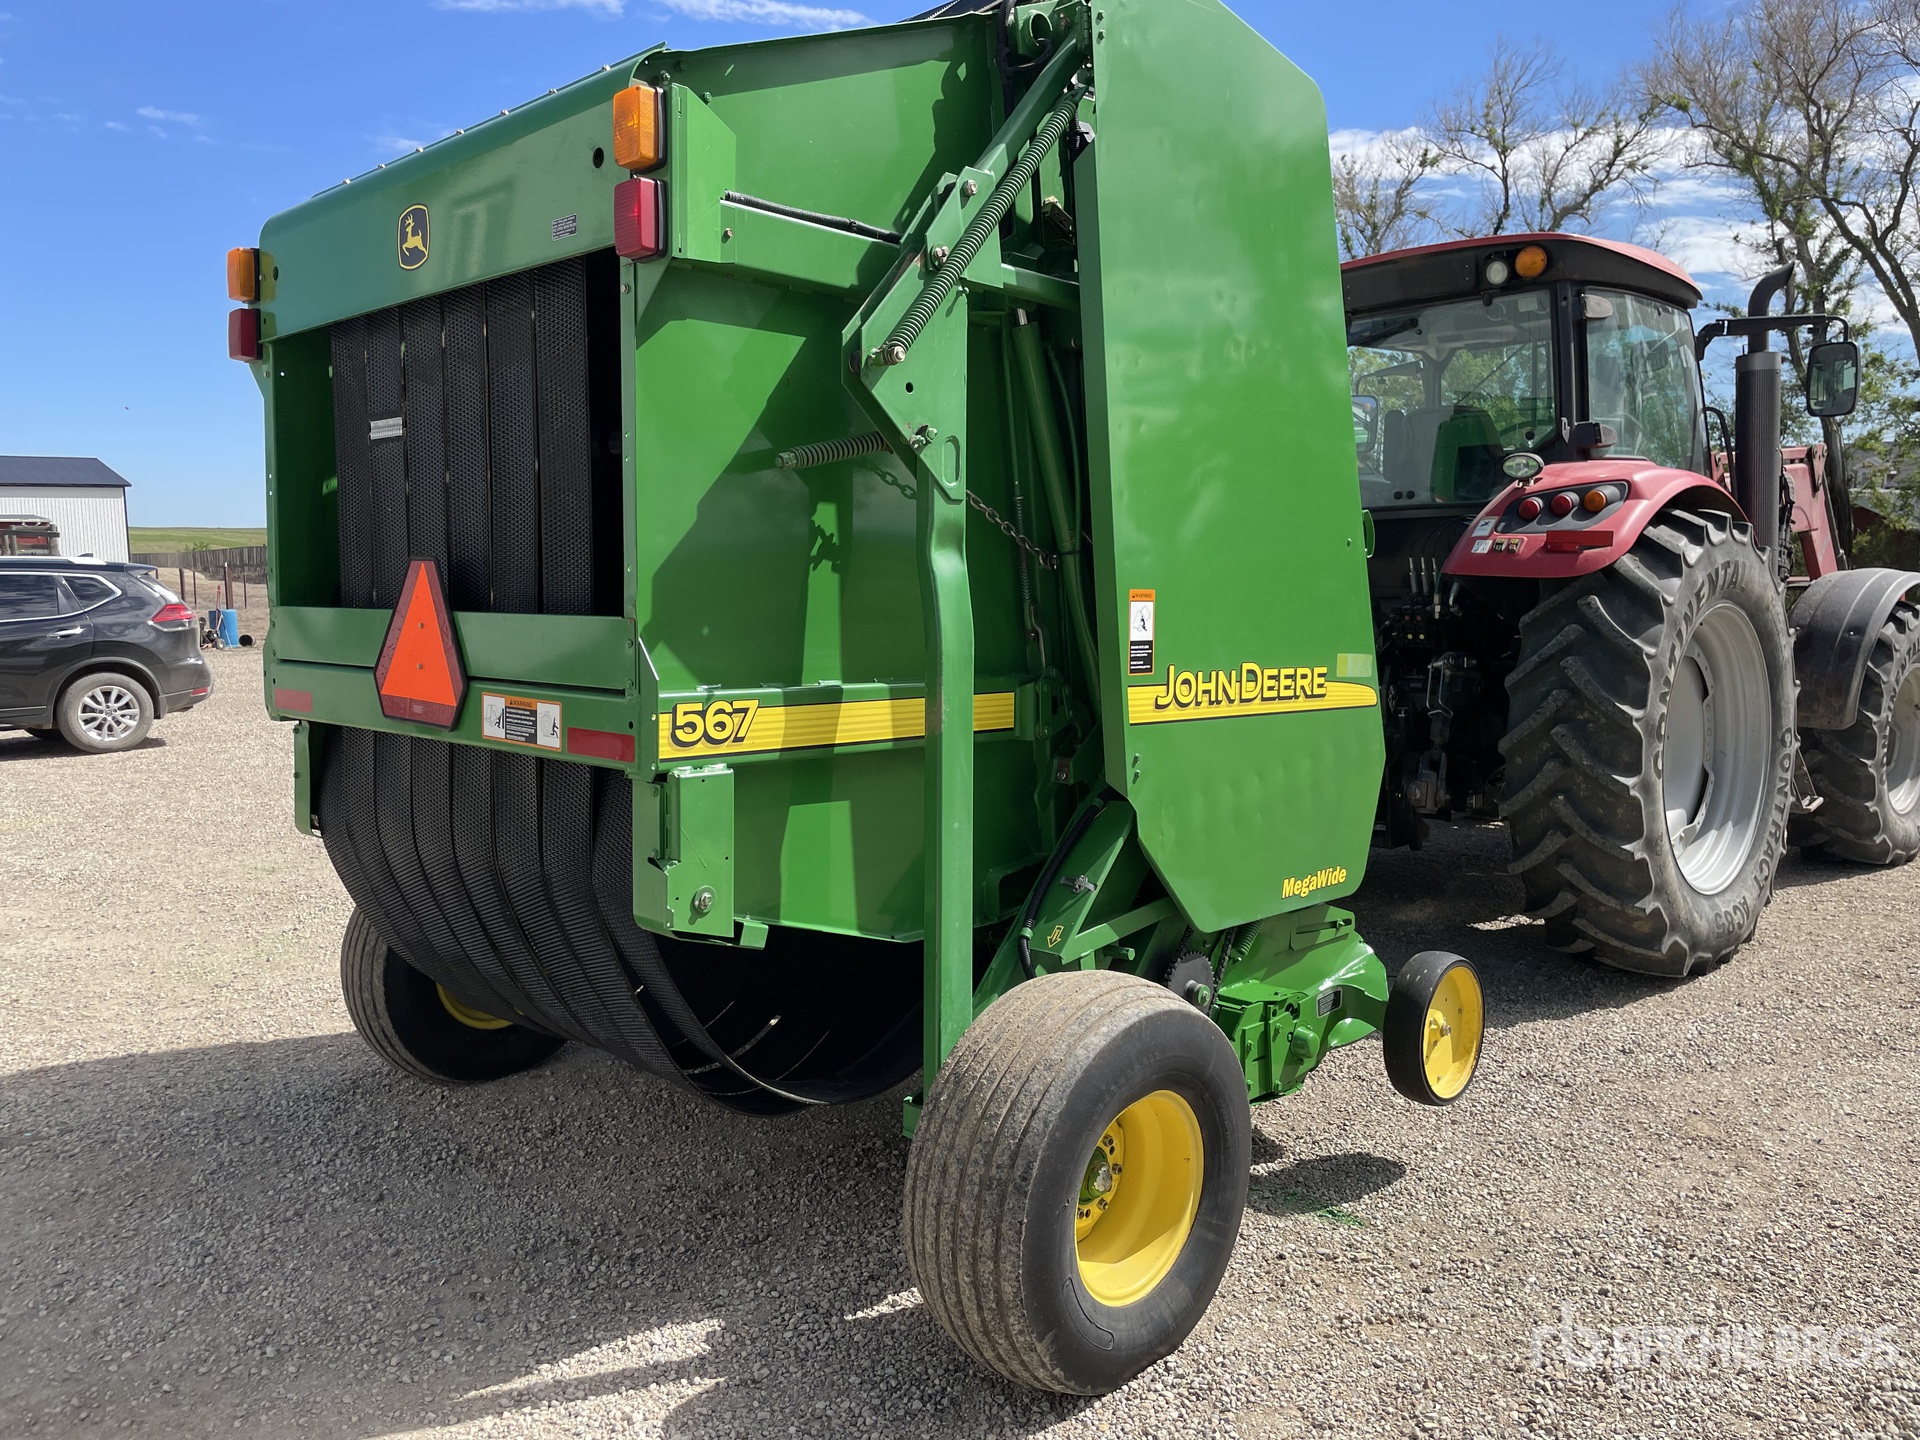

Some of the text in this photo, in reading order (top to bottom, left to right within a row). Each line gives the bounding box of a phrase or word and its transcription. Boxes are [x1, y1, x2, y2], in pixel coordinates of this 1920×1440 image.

[1154, 661, 1328, 709] JOHN DEERE
[670, 699, 760, 748] 567
[1752, 726, 1794, 898] CONTRACT
[1281, 865, 1347, 899] MegaWide
